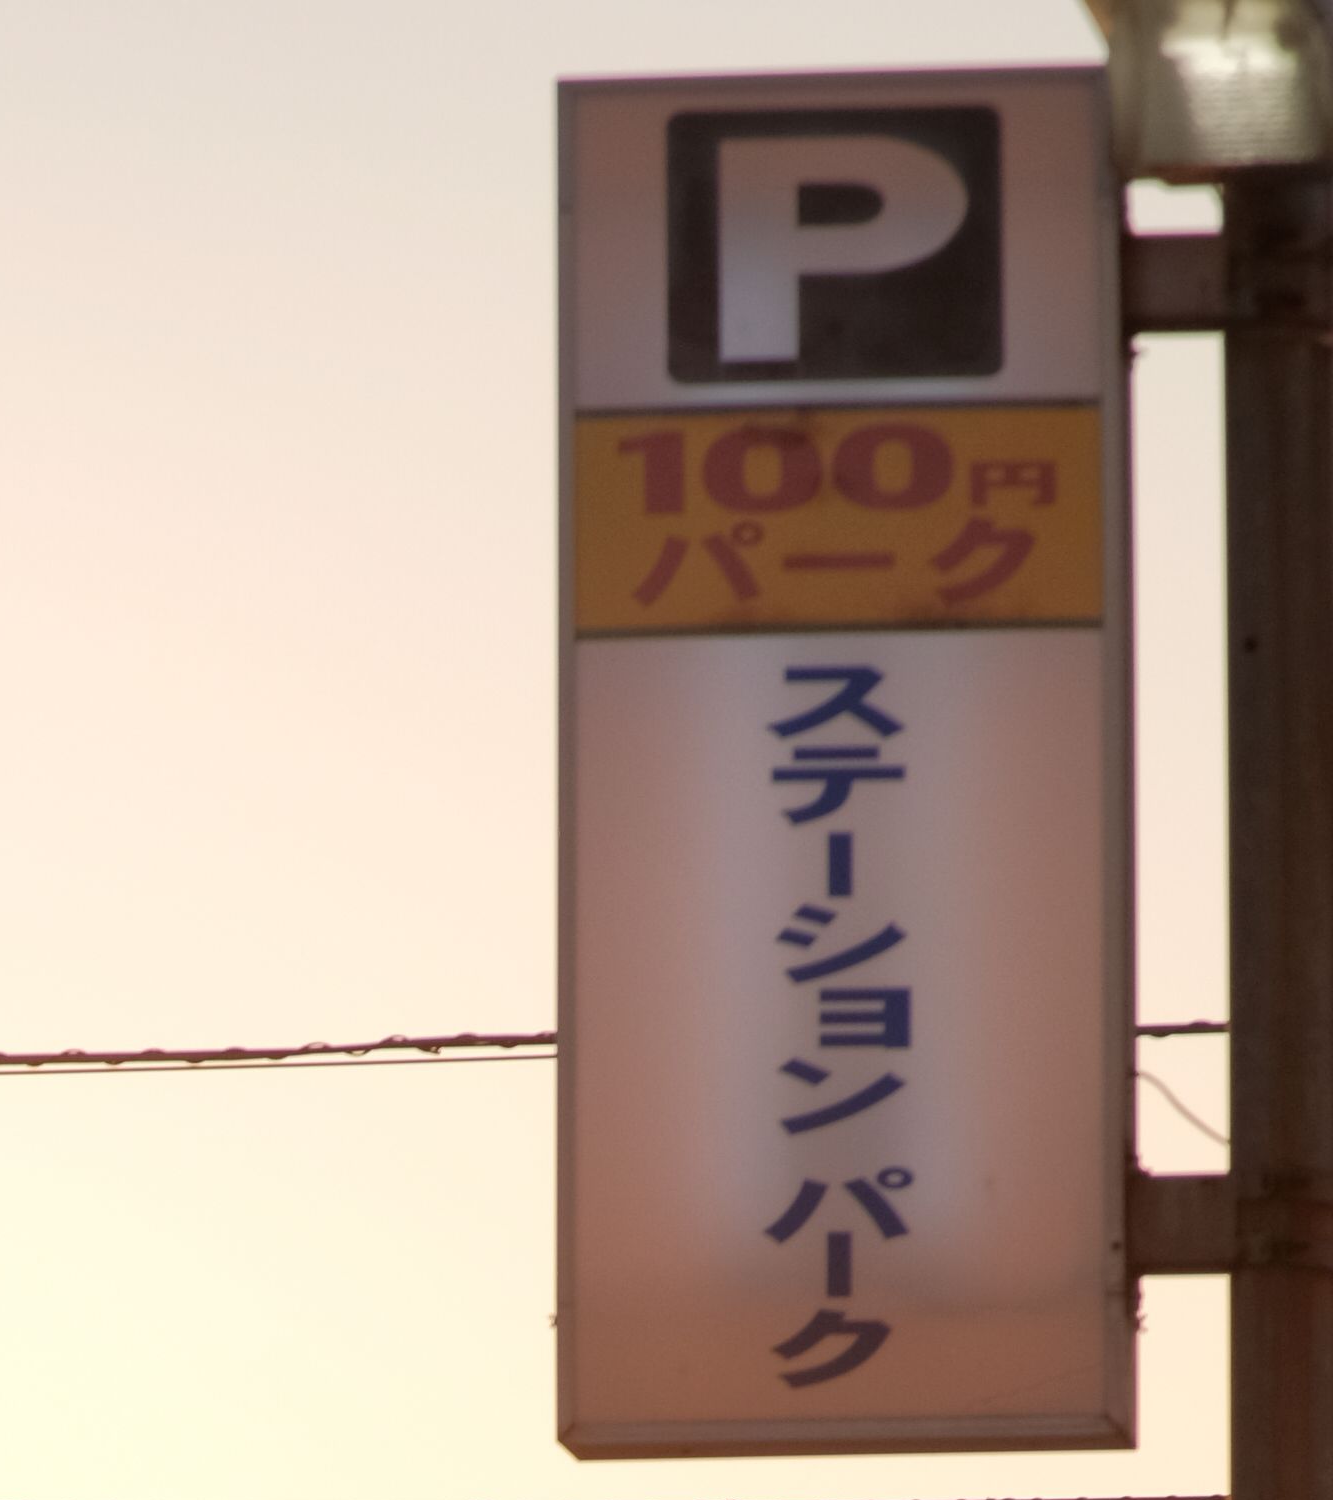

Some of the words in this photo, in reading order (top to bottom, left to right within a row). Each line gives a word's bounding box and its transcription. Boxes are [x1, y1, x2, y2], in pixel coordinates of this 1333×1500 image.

[719, 134, 969, 364] P
[615, 421, 1059, 516] 100円
[633, 516, 1039, 608] パーク
